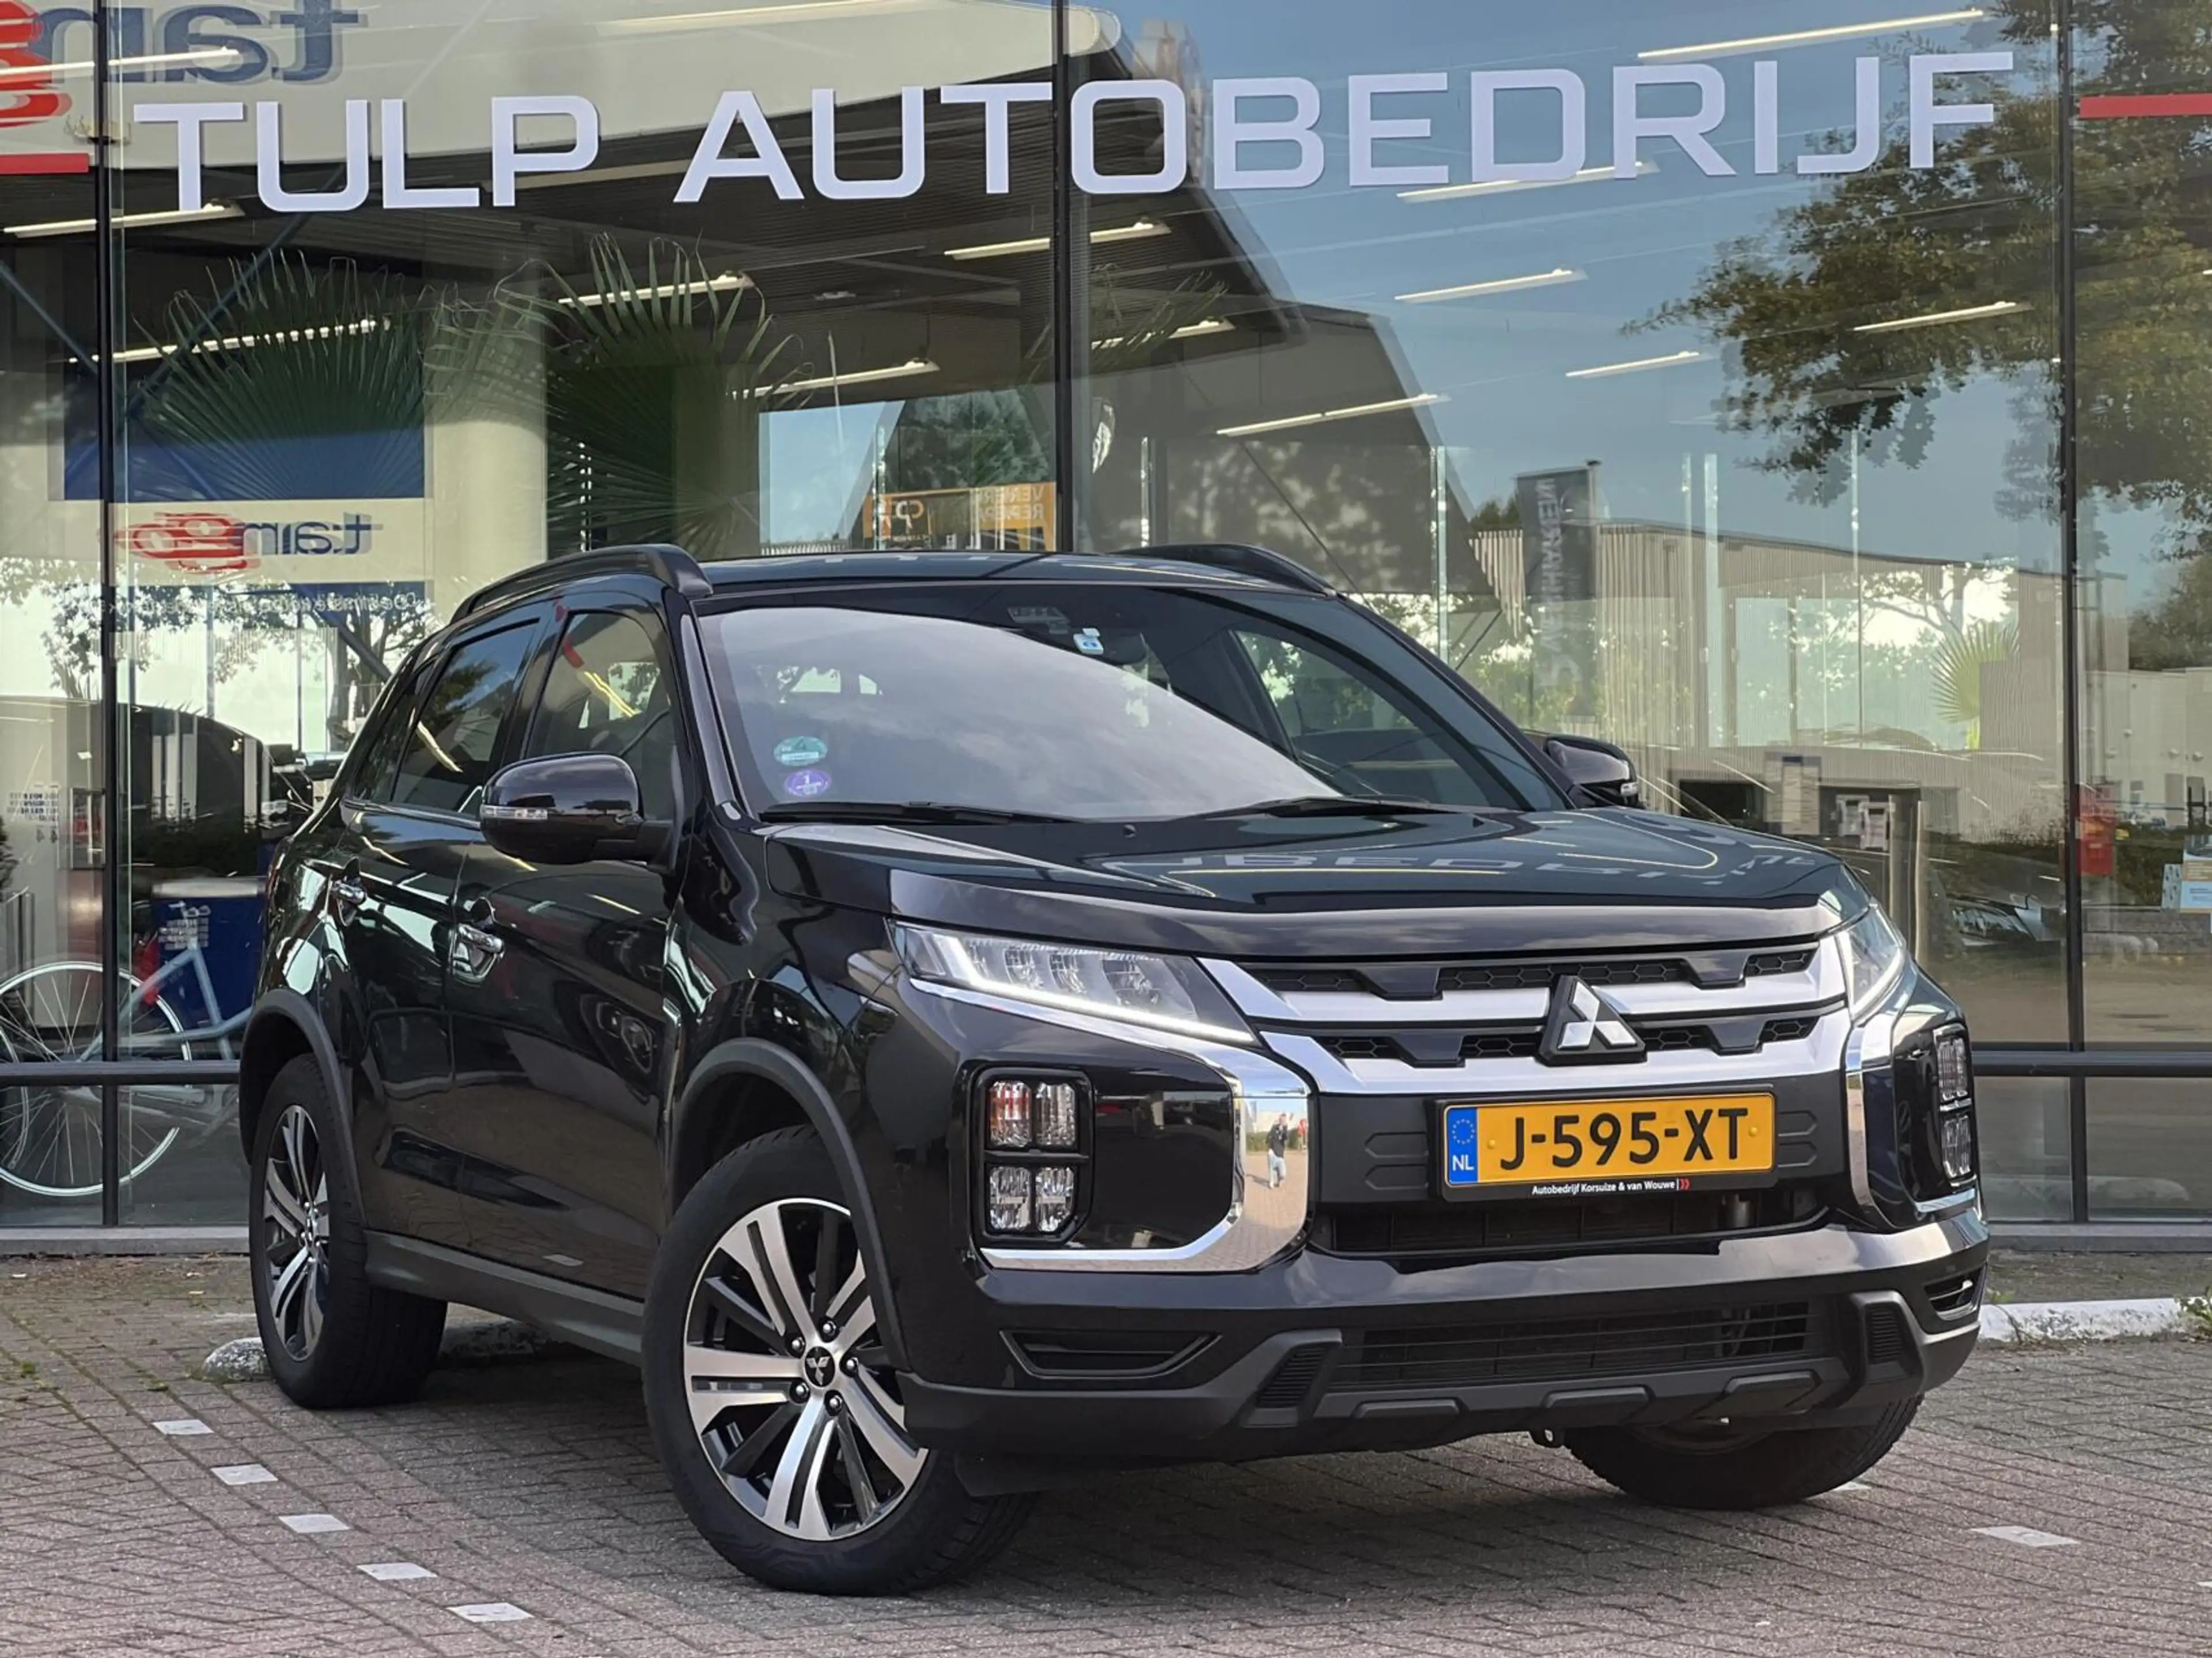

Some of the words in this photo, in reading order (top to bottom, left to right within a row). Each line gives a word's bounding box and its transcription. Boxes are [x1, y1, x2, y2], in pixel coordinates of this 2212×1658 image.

[133, 94, 600, 213] TULP
[672, 52, 2014, 203] AUTOBEDRIJF
[1500, 1107, 1749, 1171] J-595-XT
[1452, 1154, 1475, 1172] NL
[1532, 1182, 1580, 1196] Autobedrijf
[1581, 1181, 1616, 1193] Korsuize
[1618, 1181, 1626, 1192] &
[1627, 1181, 1642, 1191] van
[1643, 1179, 1675, 1190] Wouwe
